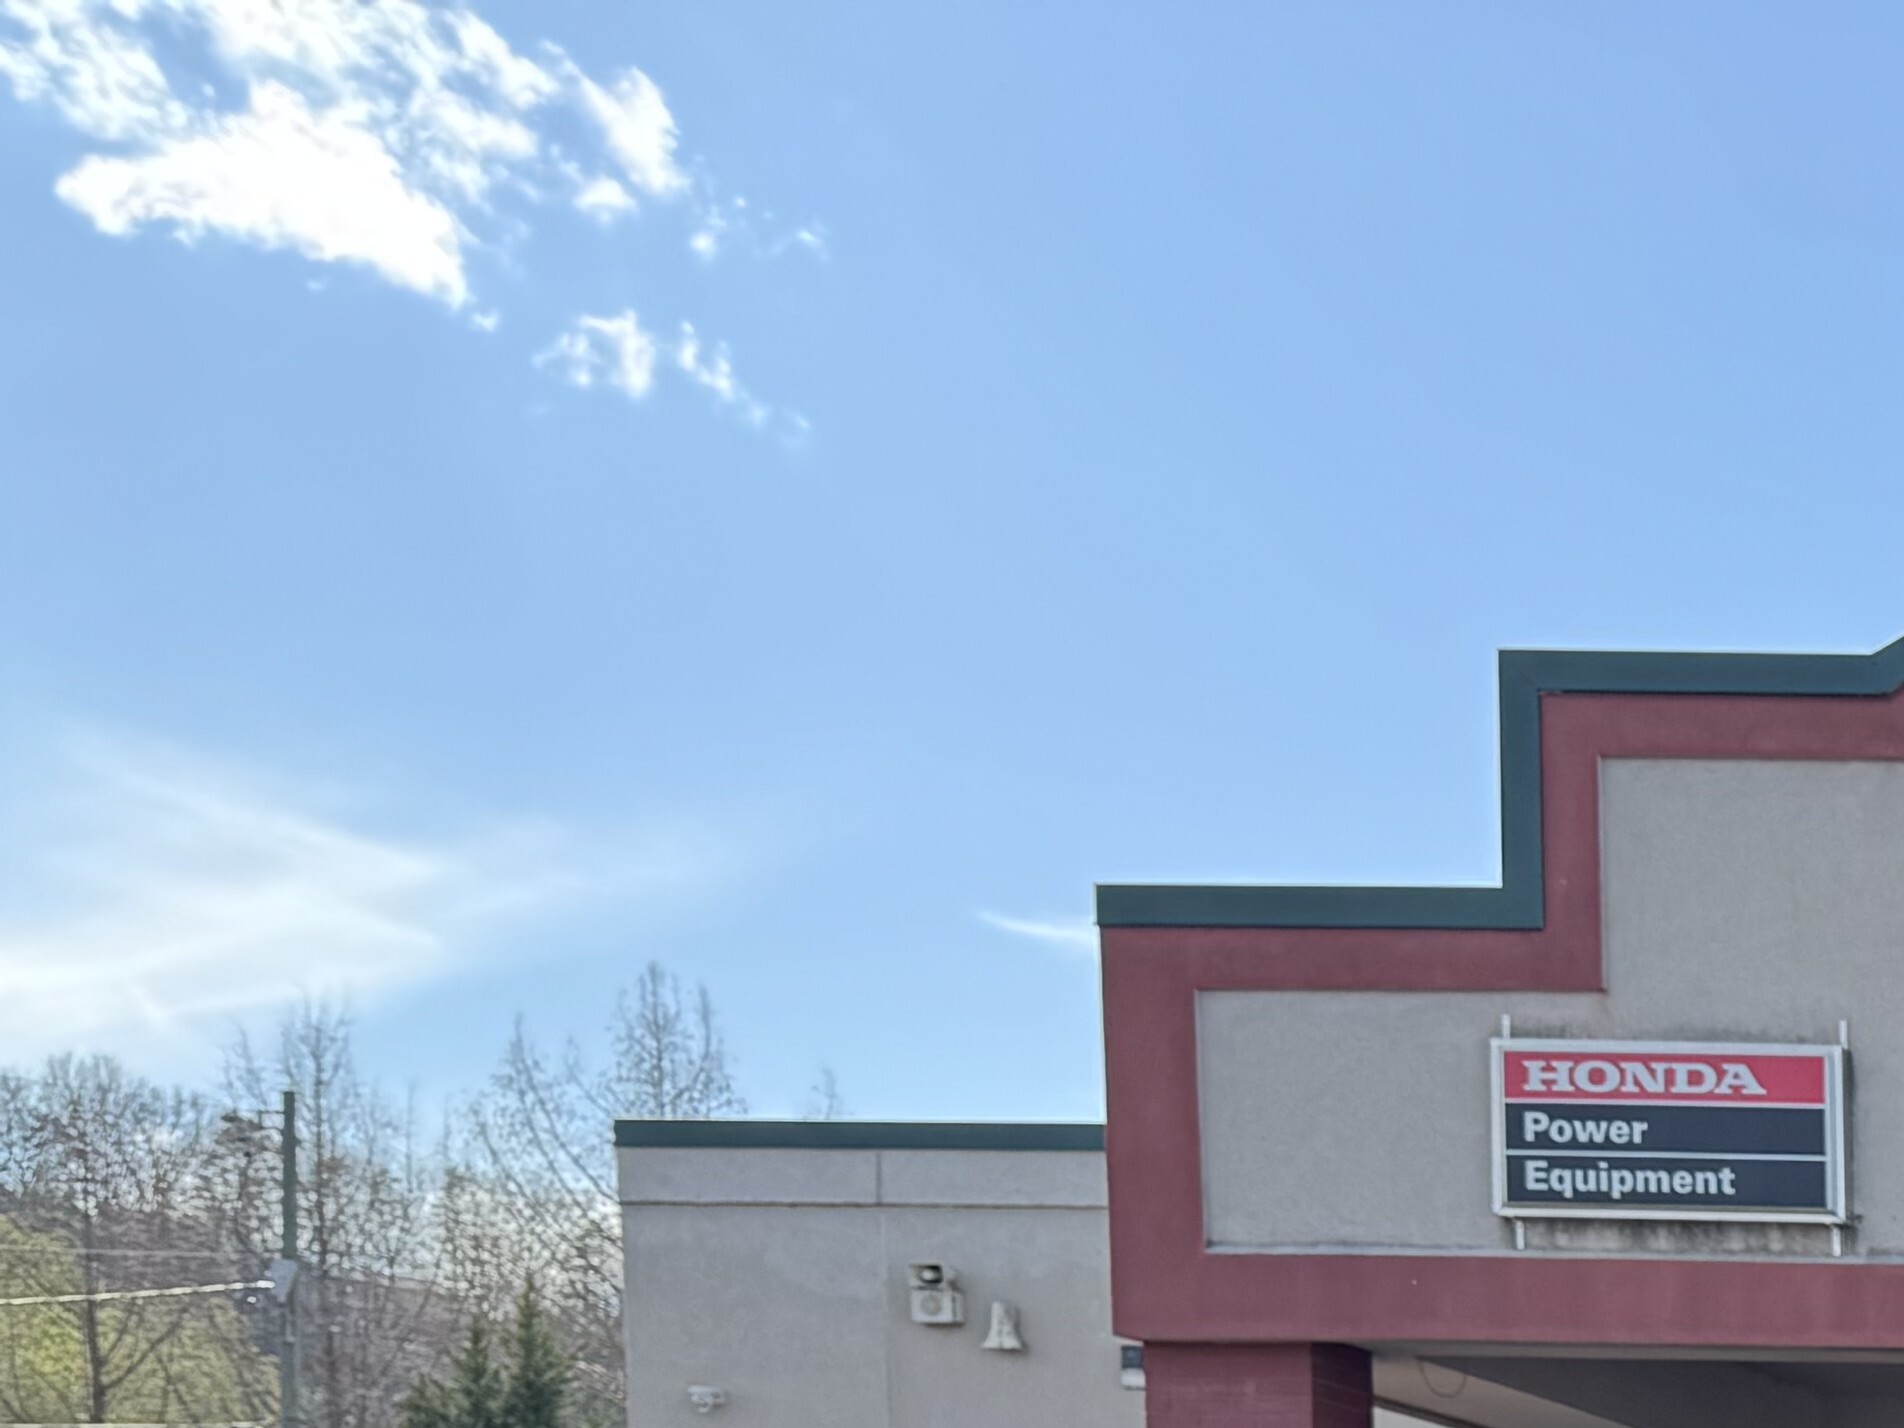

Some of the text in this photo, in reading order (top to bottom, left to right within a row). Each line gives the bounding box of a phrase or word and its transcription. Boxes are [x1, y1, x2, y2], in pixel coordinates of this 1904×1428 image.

[1521, 1058, 1768, 1096] HONDA
[1522, 1110, 1649, 1145] Power
[1523, 1160, 1736, 1200] Equipment
